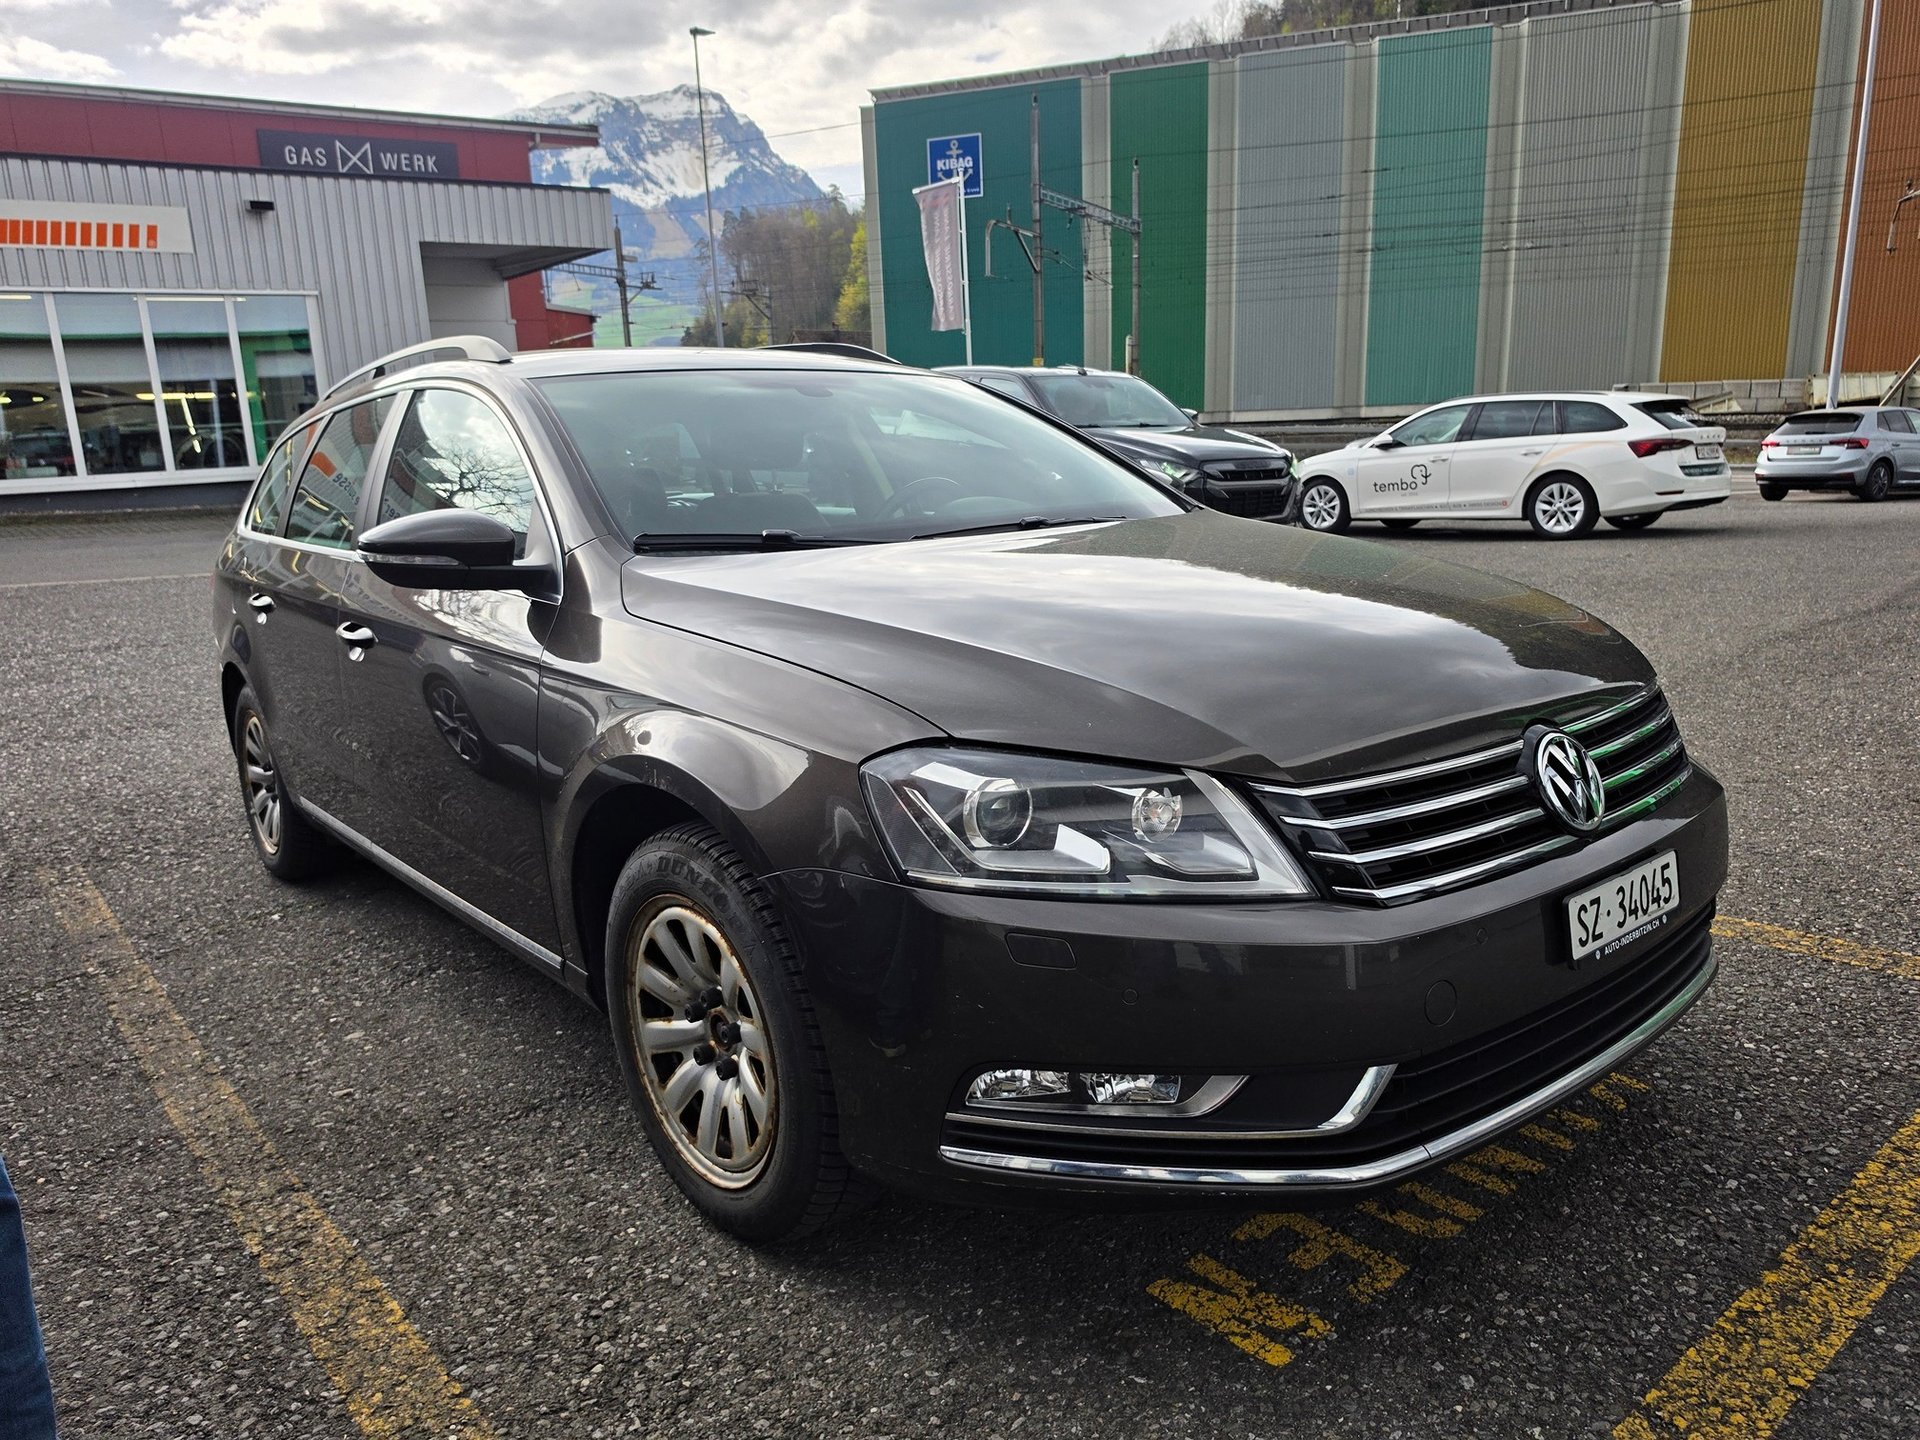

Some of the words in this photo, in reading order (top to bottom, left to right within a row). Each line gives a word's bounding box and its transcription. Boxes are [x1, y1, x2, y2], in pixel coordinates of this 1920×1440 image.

[284, 145, 327, 167] GAS
[380, 152, 439, 173] WERK
[937, 156, 973, 171] KIBAG
[1373, 478, 1417, 492] tembo
[1604, 918, 1660, 956] AUTO-INDERBITZIN.CH
